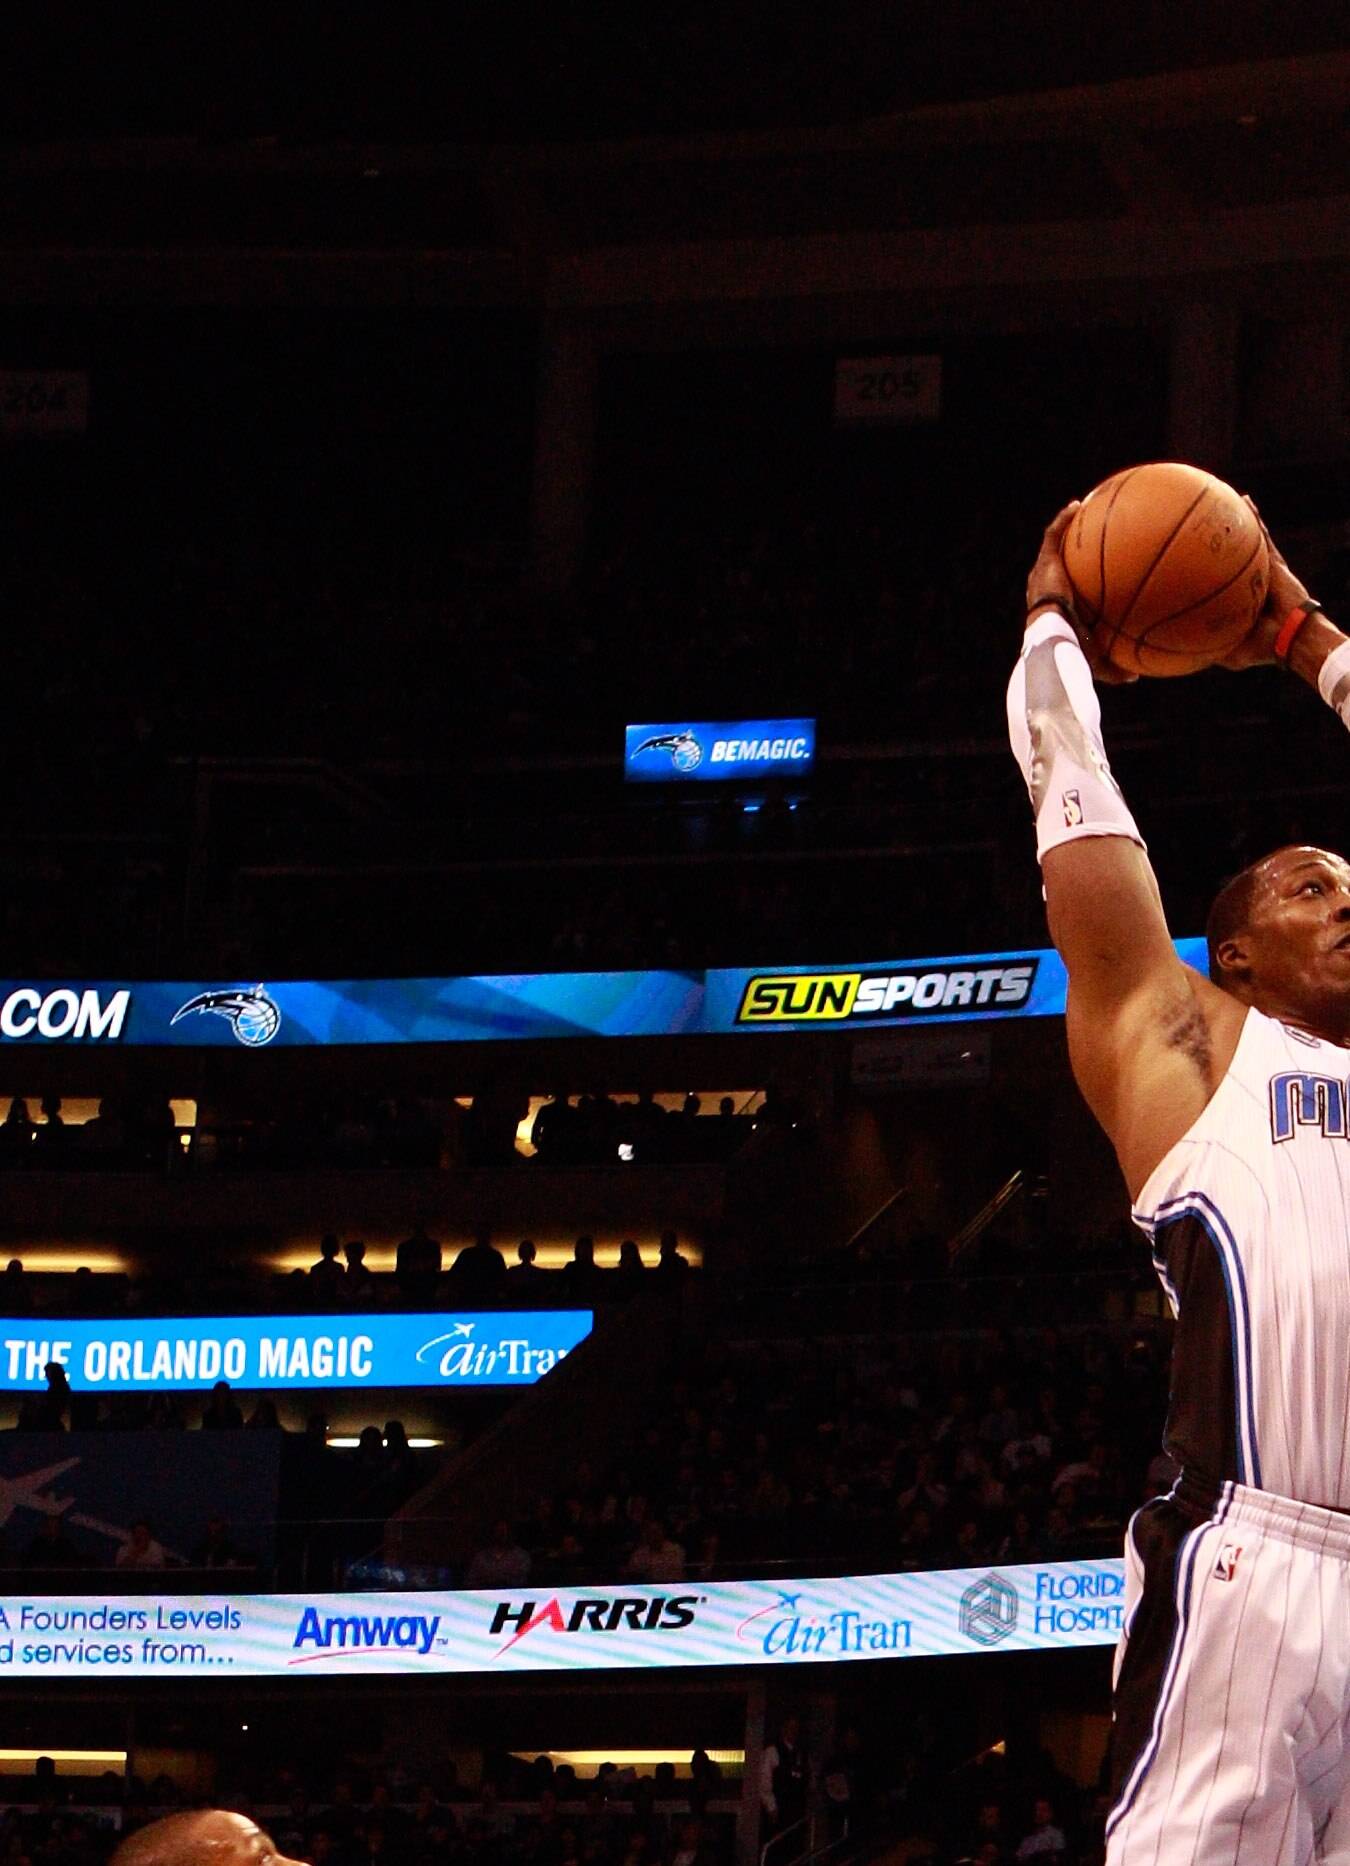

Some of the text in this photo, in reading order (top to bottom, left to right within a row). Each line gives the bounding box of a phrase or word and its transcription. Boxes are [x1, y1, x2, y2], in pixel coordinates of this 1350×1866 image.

[4, 1335, 373, 1383] THE ORLANDO MAGIC
[439, 1339, 570, 1377] airTra
[20, 1604, 148, 1631] Founders
[156, 1604, 242, 1631] Levels
[293, 1605, 442, 1655] Amway
[488, 1596, 700, 1650] HARRIS
[762, 1611, 913, 1657] airTran
[1034, 1603, 1125, 1634] HOSPIT
[22, 1638, 134, 1665] services
